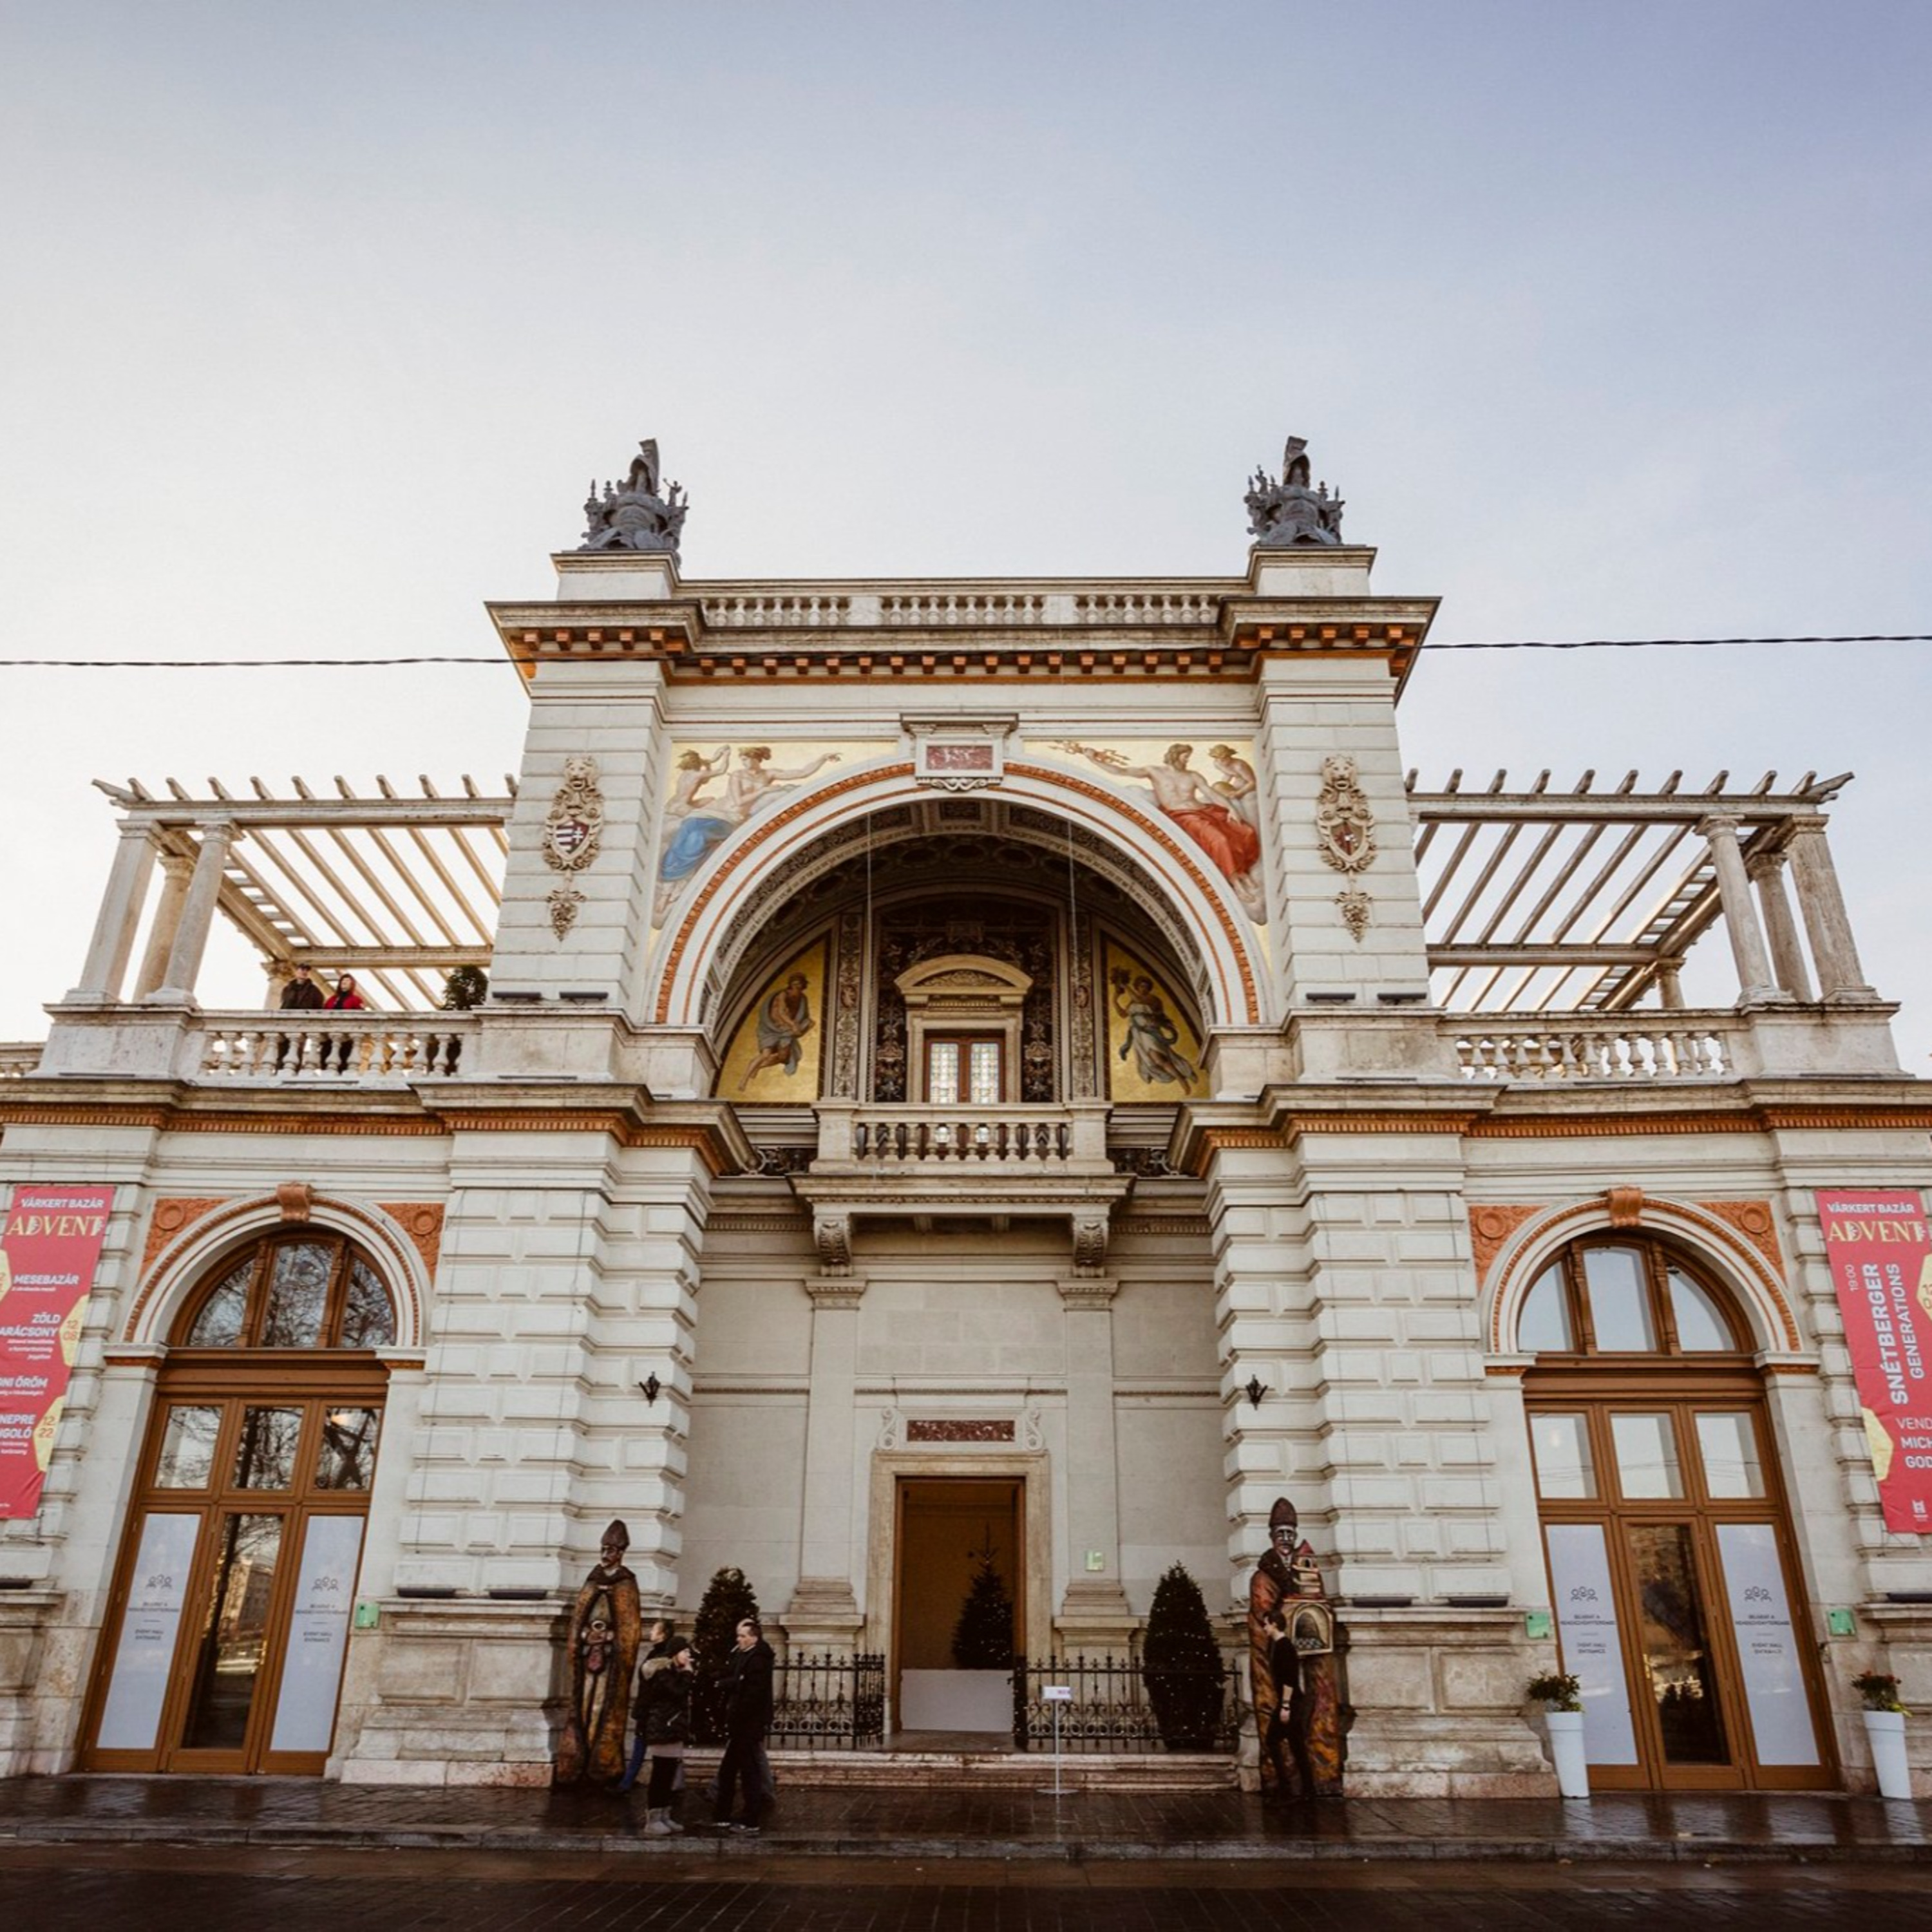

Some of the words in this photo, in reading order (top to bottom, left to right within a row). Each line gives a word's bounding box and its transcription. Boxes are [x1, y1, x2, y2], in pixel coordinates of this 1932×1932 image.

[21, 1197, 68, 1208] VÁRKERT
[69, 1197, 104, 1208] BAZÁR
[1826, 1202, 1875, 1213] VÁRKERT
[1877, 1202, 1915, 1213] BAZÁR
[6, 1215, 104, 1236] ADVENT
[1828, 1220, 1926, 1242] ADVENT
[14, 1273, 79, 1285] MESEBAZÁR
[32, 1311, 61, 1323] ZÖLD
[1886, 1264, 1924, 1379] GENERATIONS
[1862, 1264, 1908, 1405] SNÉTBERGER
